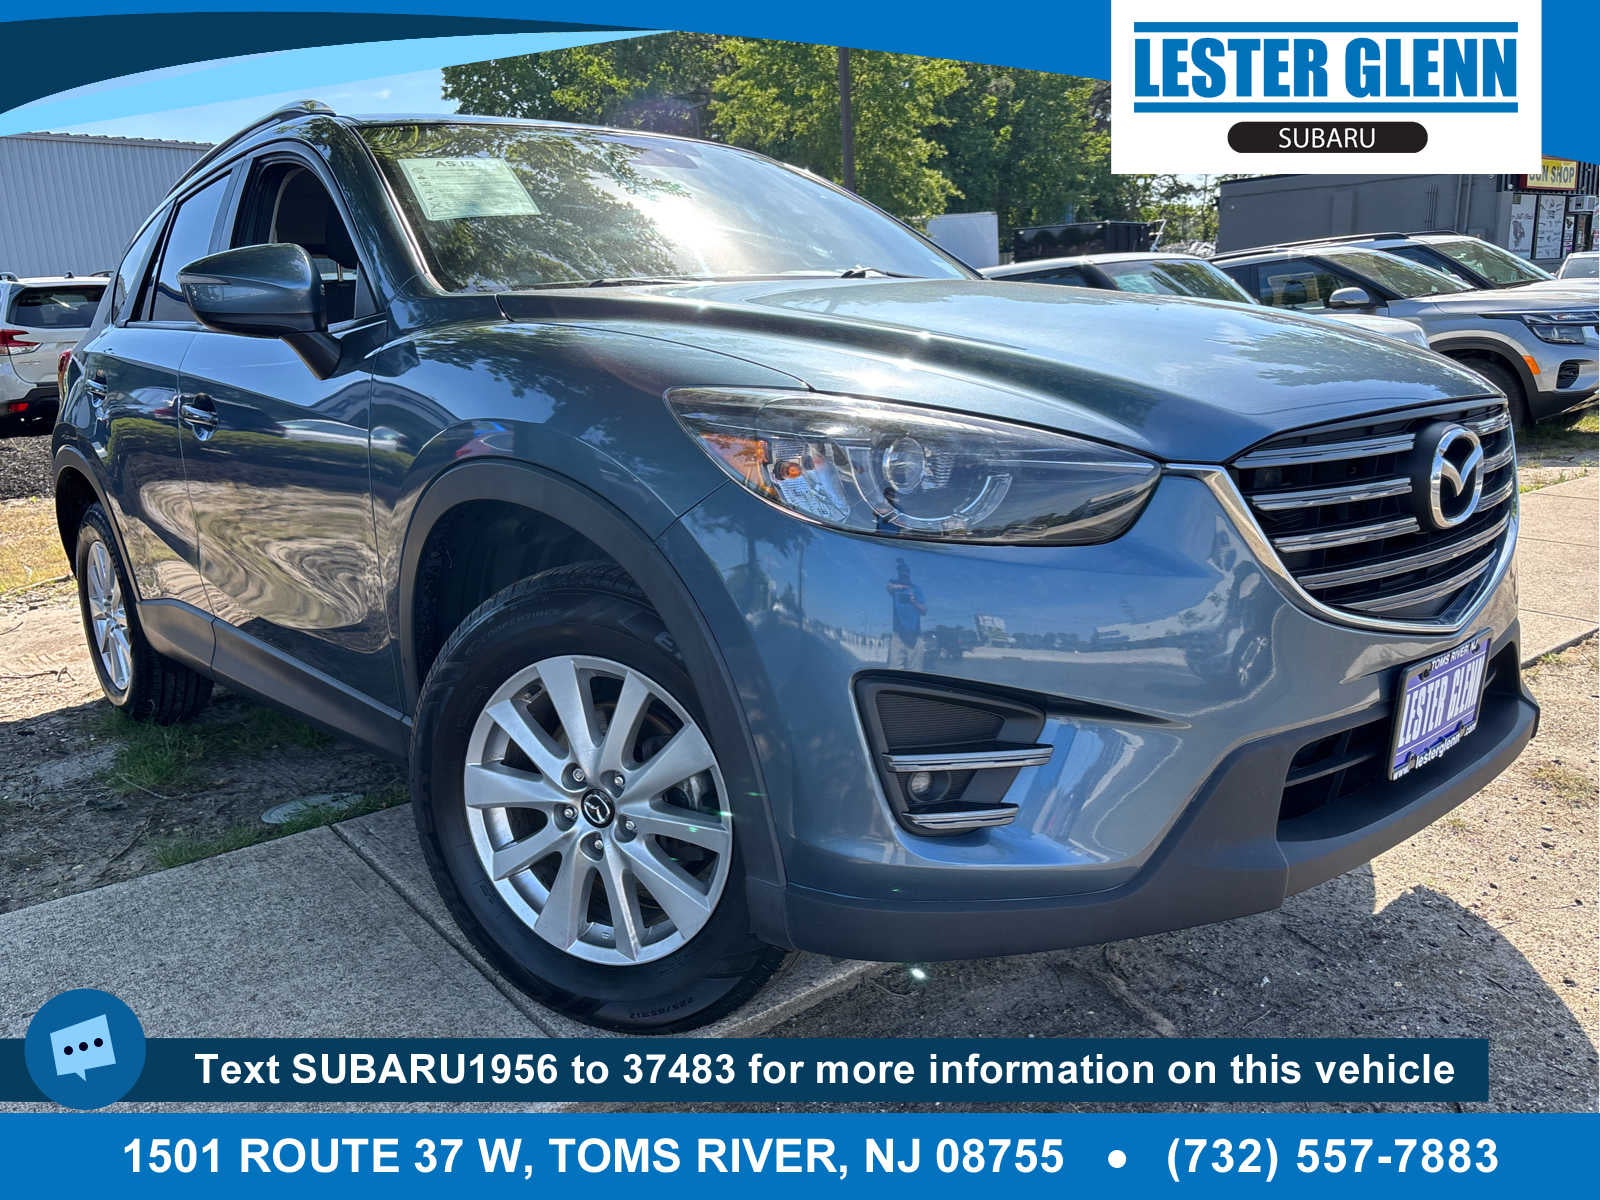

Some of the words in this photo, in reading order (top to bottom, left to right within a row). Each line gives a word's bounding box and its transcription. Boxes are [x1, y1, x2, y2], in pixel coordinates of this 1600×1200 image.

[435, 160, 456, 168] AS
[1551, 165, 1575, 183] SHOP
[1431, 653, 1450, 670] TOMS
[1397, 675, 1449, 748] LESTER
[1447, 653, 1486, 721] GLENN
